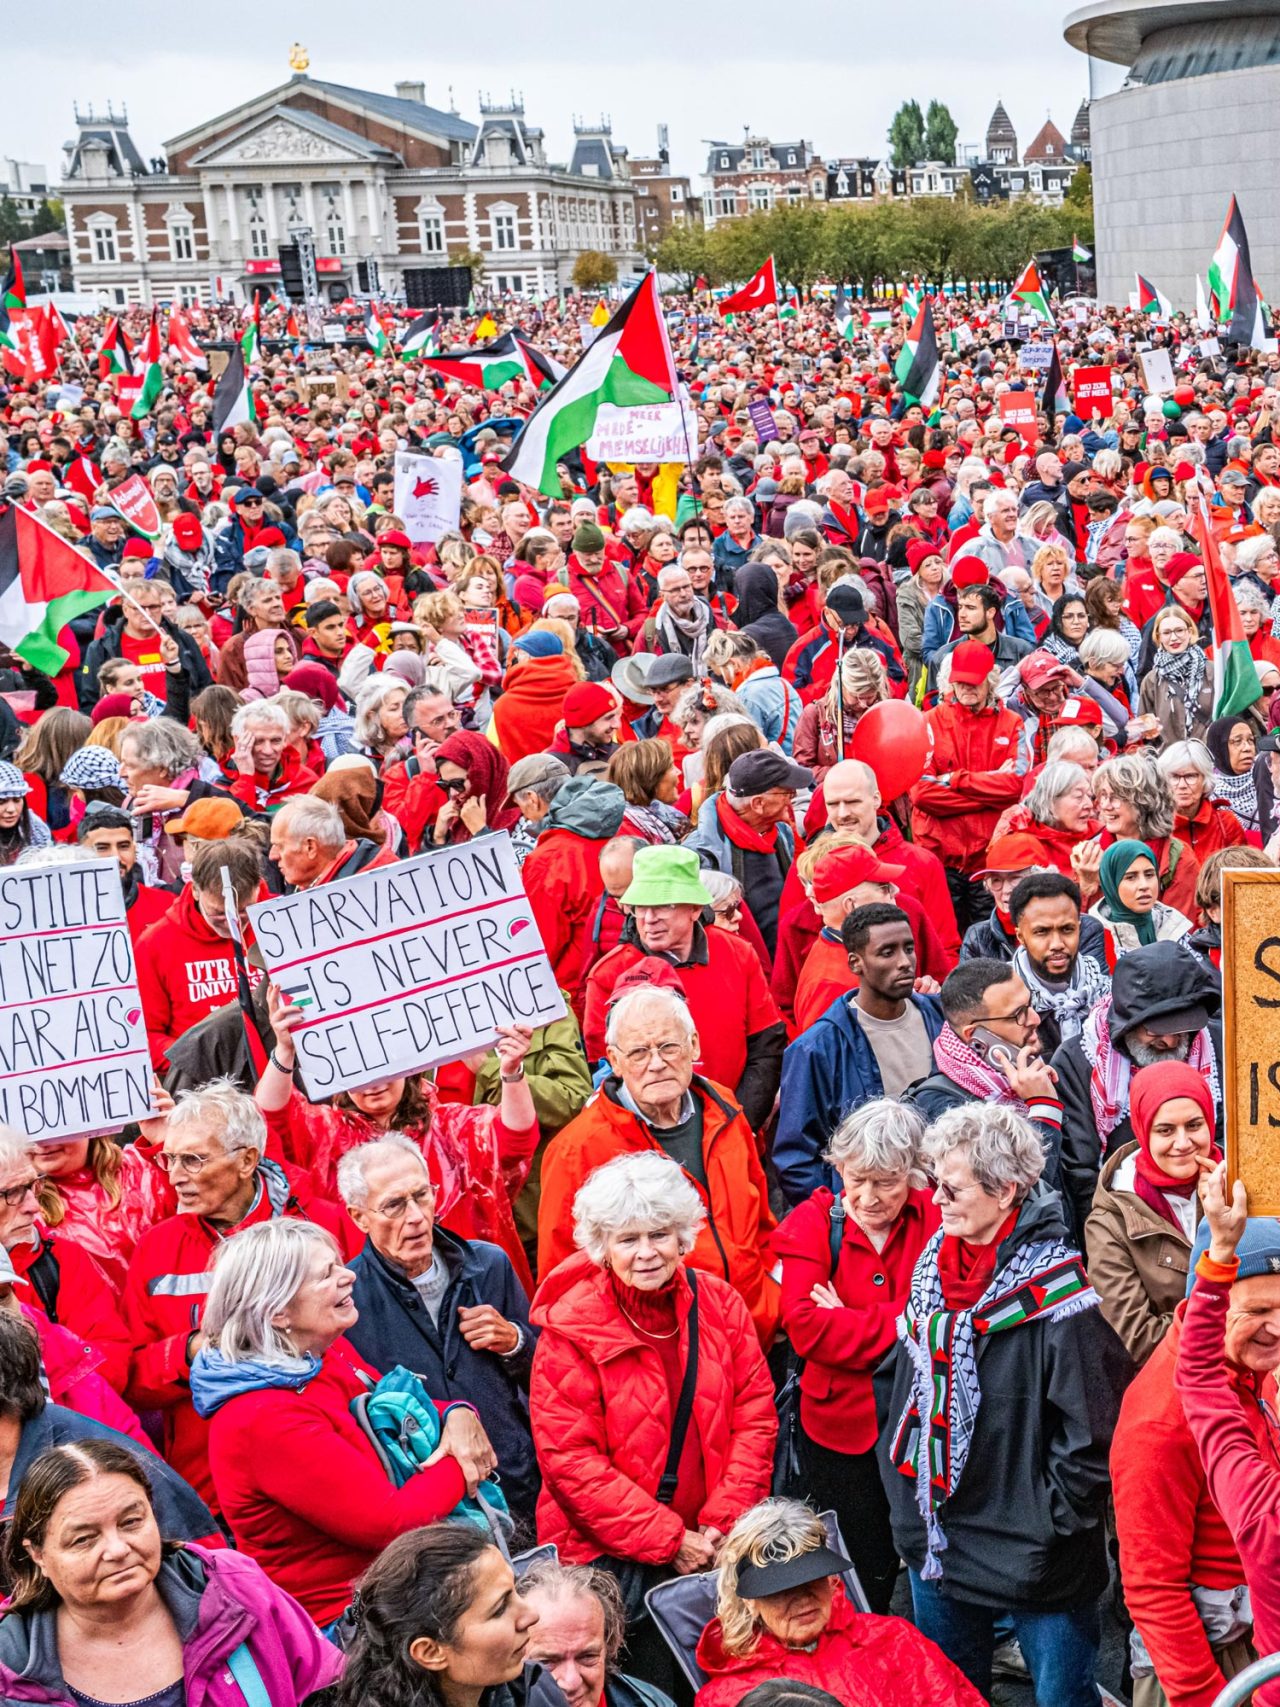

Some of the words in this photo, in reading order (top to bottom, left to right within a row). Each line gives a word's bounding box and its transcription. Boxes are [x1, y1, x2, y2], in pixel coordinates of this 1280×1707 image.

[310, 383, 335, 396] STOP
[630, 410, 662, 421] MEER
[2, 868, 120, 930] STILTE
[257, 847, 507, 958] STARVATION
[21, 935, 83, 999] NET
[91, 930, 131, 988] ZO
[304, 960, 352, 1012] IS
[372, 917, 512, 991] NEVER
[74, 996, 130, 1057] ALS
[301, 962, 556, 1086] SELF-DEFENCE
[20, 1064, 151, 1135] BOMMEN
